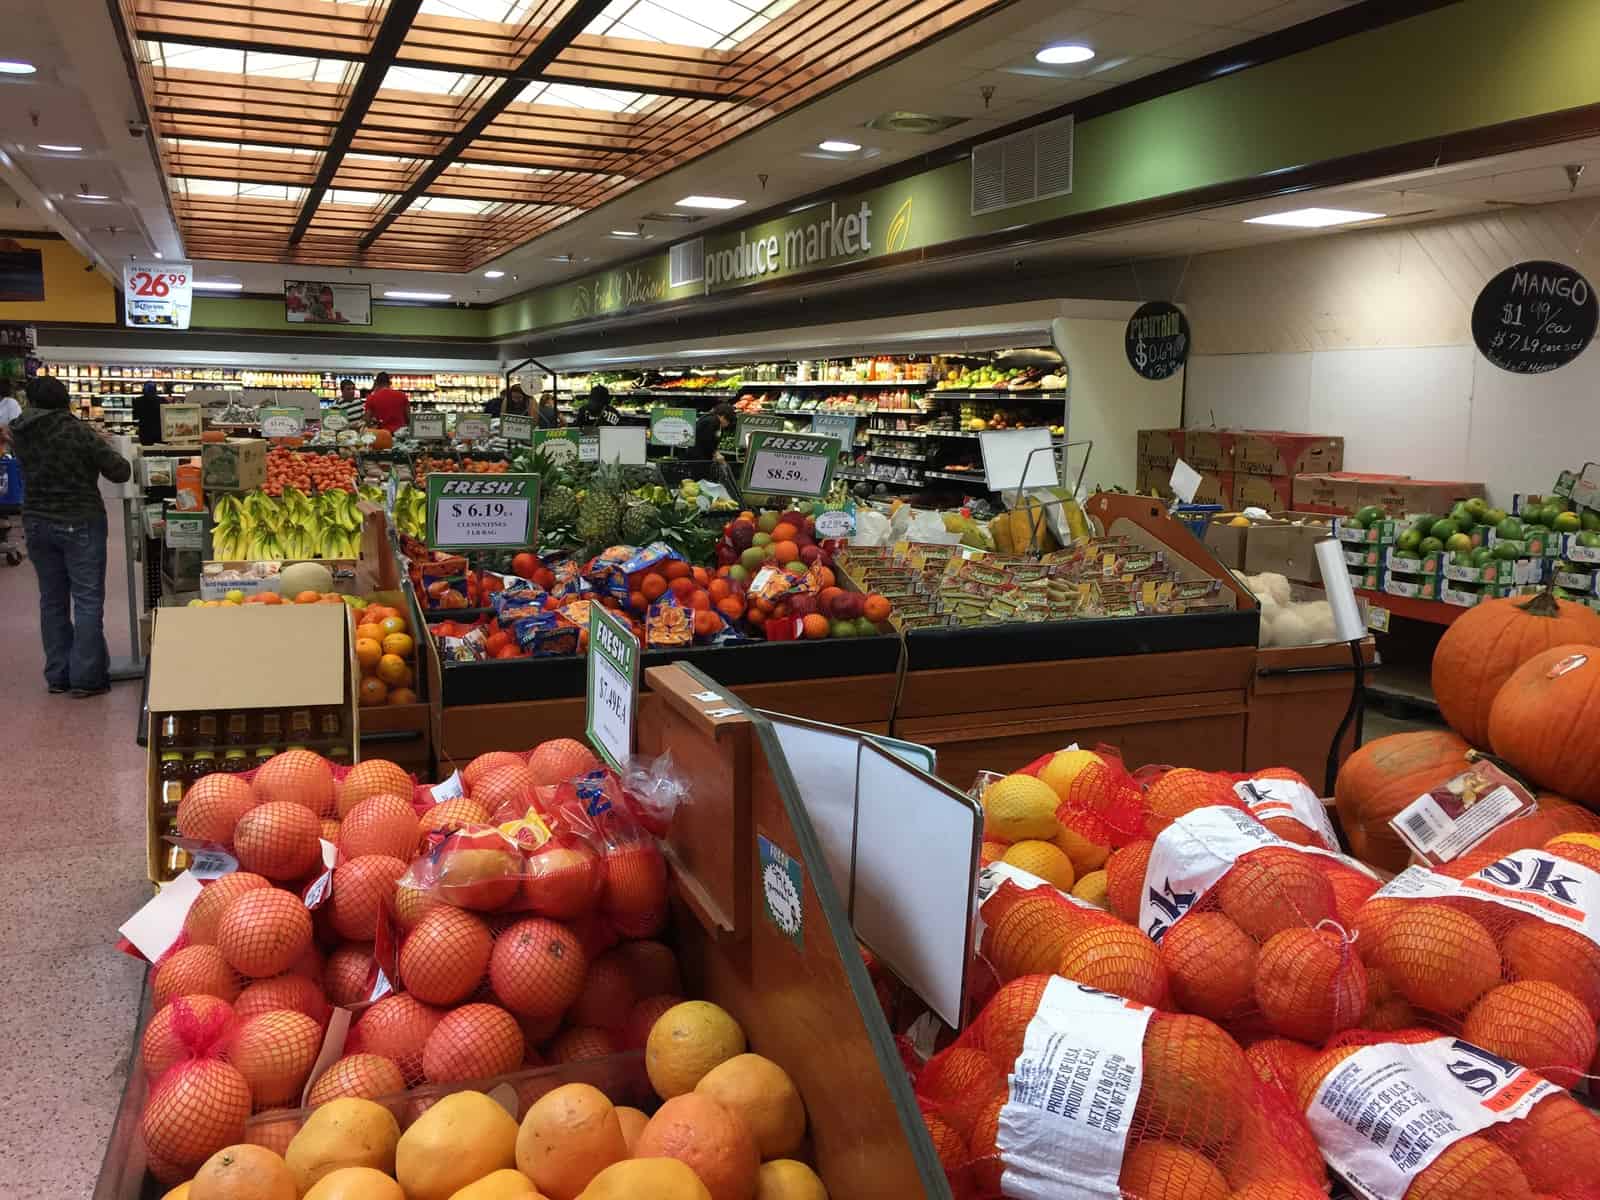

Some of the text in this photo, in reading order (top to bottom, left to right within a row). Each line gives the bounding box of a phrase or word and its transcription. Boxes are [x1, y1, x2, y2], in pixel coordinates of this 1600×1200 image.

[705, 201, 872, 295] produce market
[1511, 271, 1588, 305] MANGO
[767, 469, 800, 480] $8.59
[468, 503, 504, 517] 6.19
[1047, 1072, 1071, 1115] PRODUCE
[1063, 1081, 1087, 1120] PRODUIT
[1078, 1065, 1091, 1082] DES
[1092, 1092, 1108, 1111] WT
[1110, 1089, 1128, 1106] NET
[1087, 1107, 1104, 1128] NET
[1102, 1105, 1123, 1134] POIDS
[1355, 1099, 1384, 1137] PRODUCE
[1378, 1088, 1394, 1104] OF
[1389, 1100, 1411, 1118] DES
[1397, 1129, 1415, 1150] WT
[1389, 1143, 1406, 1164] NET
[1397, 1147, 1423, 1173] POIDS
[1413, 1131, 1435, 1152] NET
